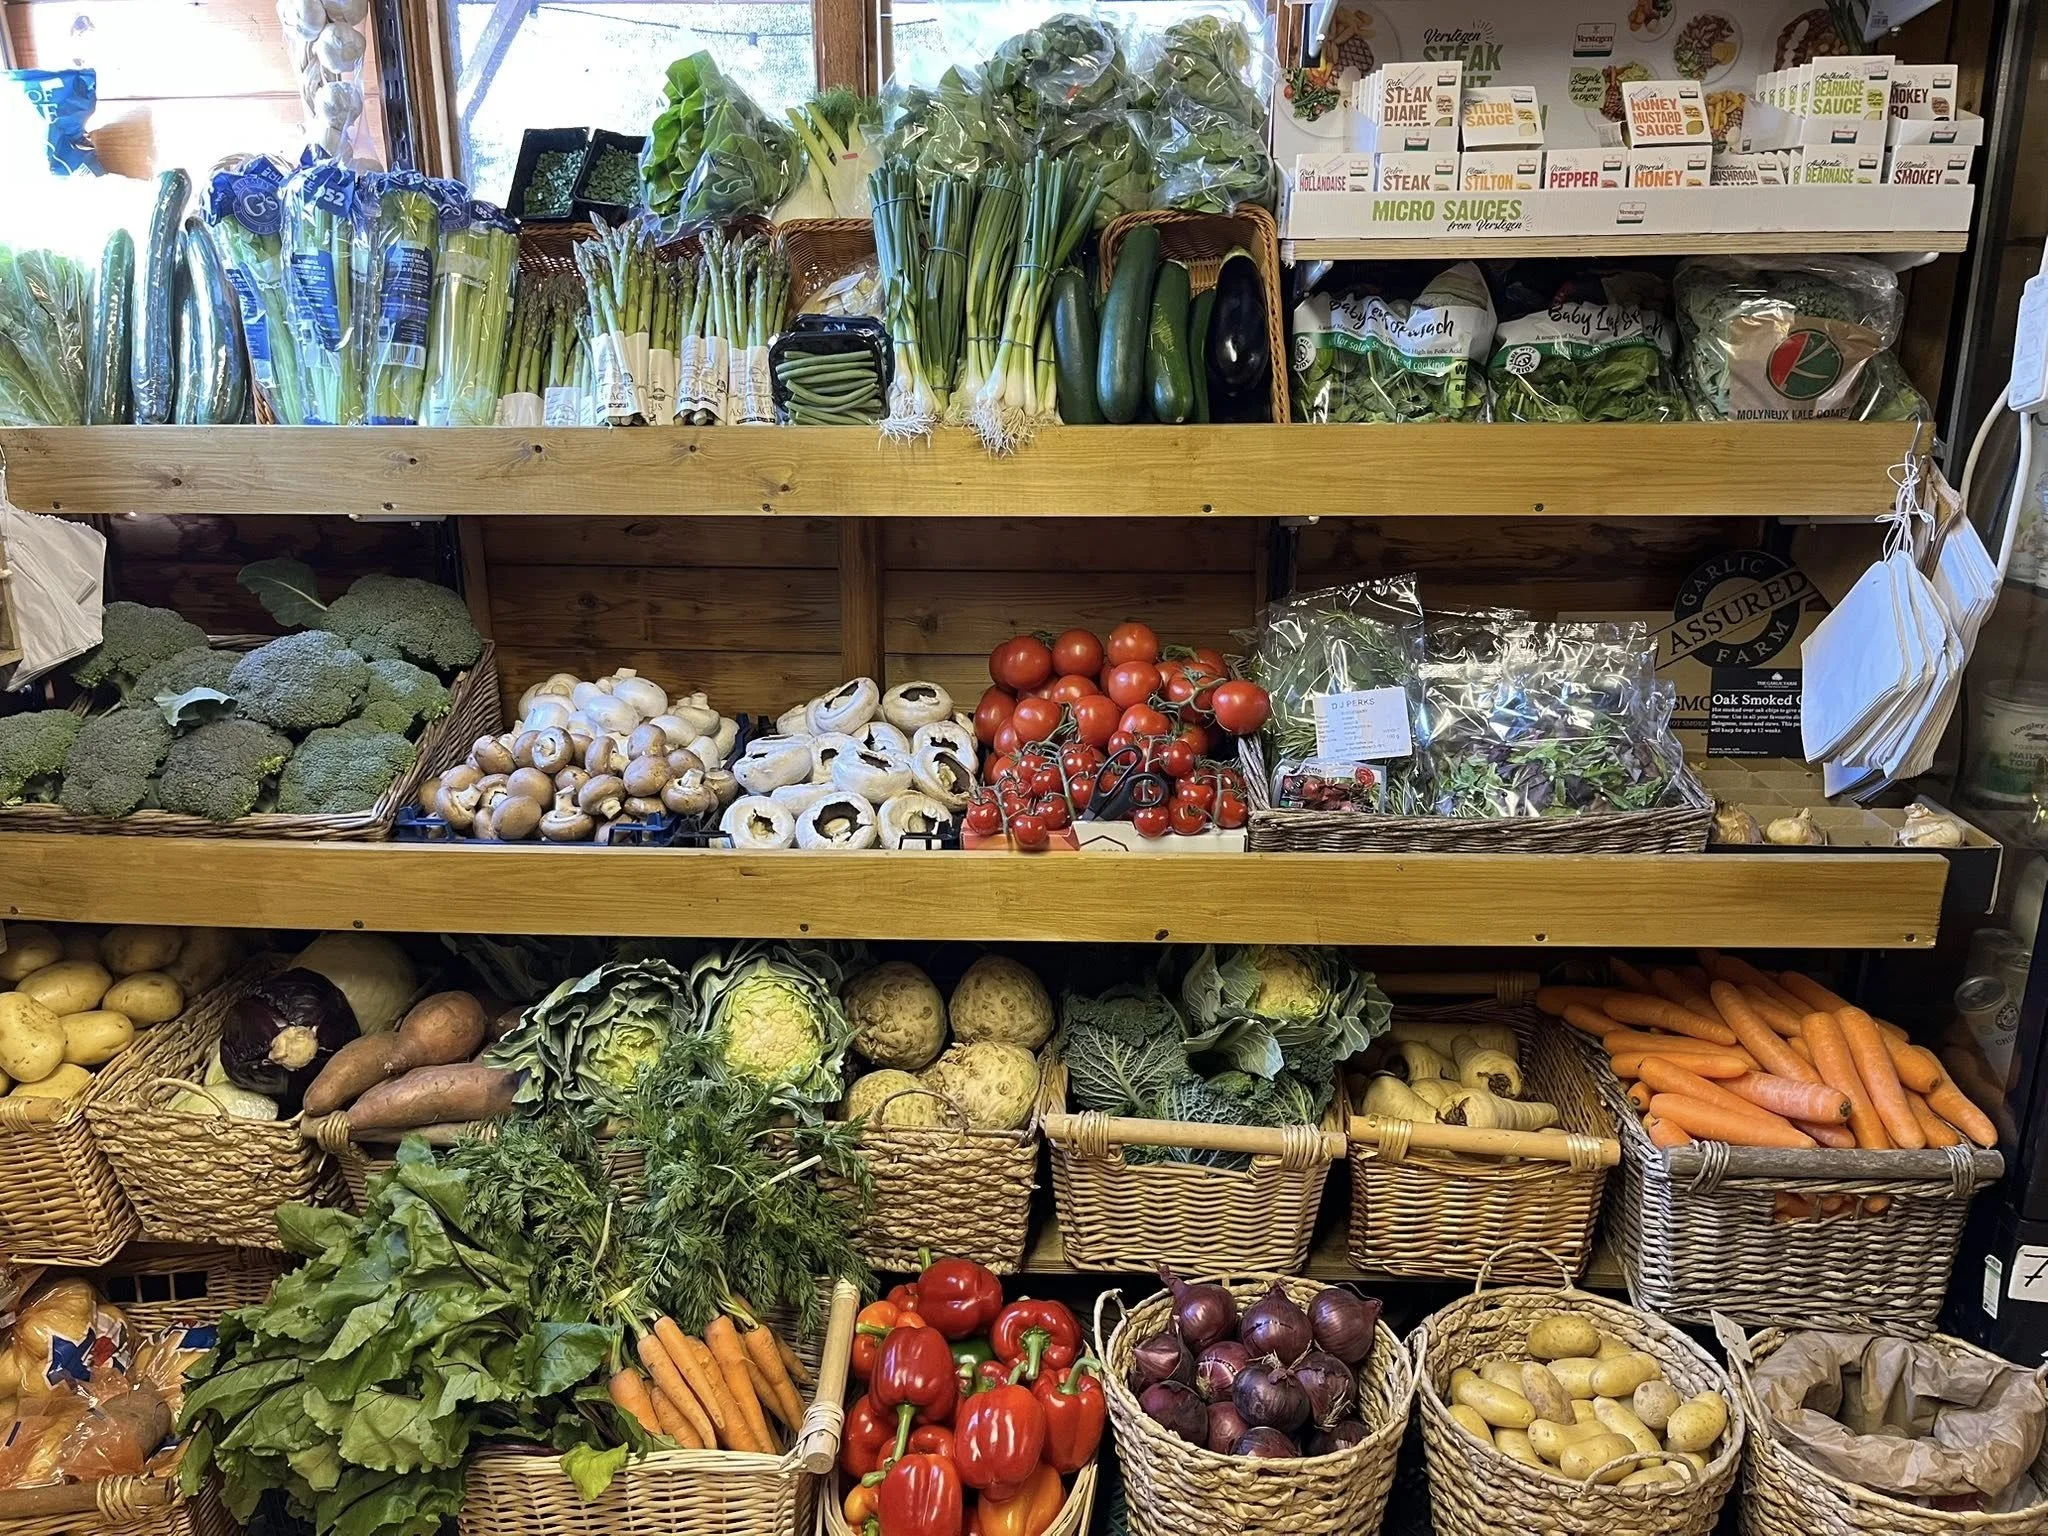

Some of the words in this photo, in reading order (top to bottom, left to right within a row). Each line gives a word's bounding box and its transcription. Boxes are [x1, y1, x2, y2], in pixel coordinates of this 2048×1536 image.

[1424, 28, 1482, 46] Verstegen
[1423, 44, 1503, 71] STEAK
[1571, 73, 1602, 85] Simply
[1385, 86, 1433, 104] STEAK
[1814, 80, 1865, 97] BEARNAISE
[1890, 89, 1929, 104] MOKEY
[1384, 104, 1427, 121] DIANE
[1465, 103, 1513, 116] STILTON
[1631, 98, 1678, 111] HONEY
[1812, 97, 1862, 114] SAUCE
[1466, 115, 1515, 127] SAUCE
[1632, 111, 1682, 124] MUSTARD
[1635, 124, 1685, 137] SAUCE
[1300, 175, 1347, 192] HOLLANDAISE
[1383, 175, 1431, 191] STEAK
[1465, 174, 1513, 190] STILTON
[1550, 171, 1599, 188] PEPPER
[1635, 170, 1684, 188] HONEY
[1711, 170, 1757, 181] MUSHROOM
[1805, 168, 1856, 184] BEARNAISE
[1893, 169, 1943, 185] SMOKEY
[1373, 200, 1435, 222] MICRO
[1442, 199, 1522, 221] SAUCES
[1446, 221, 1472, 232] from
[1475, 216, 1522, 232] Verstegen
[1548, 304, 1592, 335] Baby
[1737, 409, 1789, 420] MOLYNEUX
[1682, 556, 1764, 606] GARLIC
[1670, 571, 1808, 656] ASSURED
[1716, 621, 1790, 664] FARM
[1346, 698, 1375, 708] PERKS
[1712, 694, 1739, 705] Oak
[1742, 694, 1793, 706] Smoked
